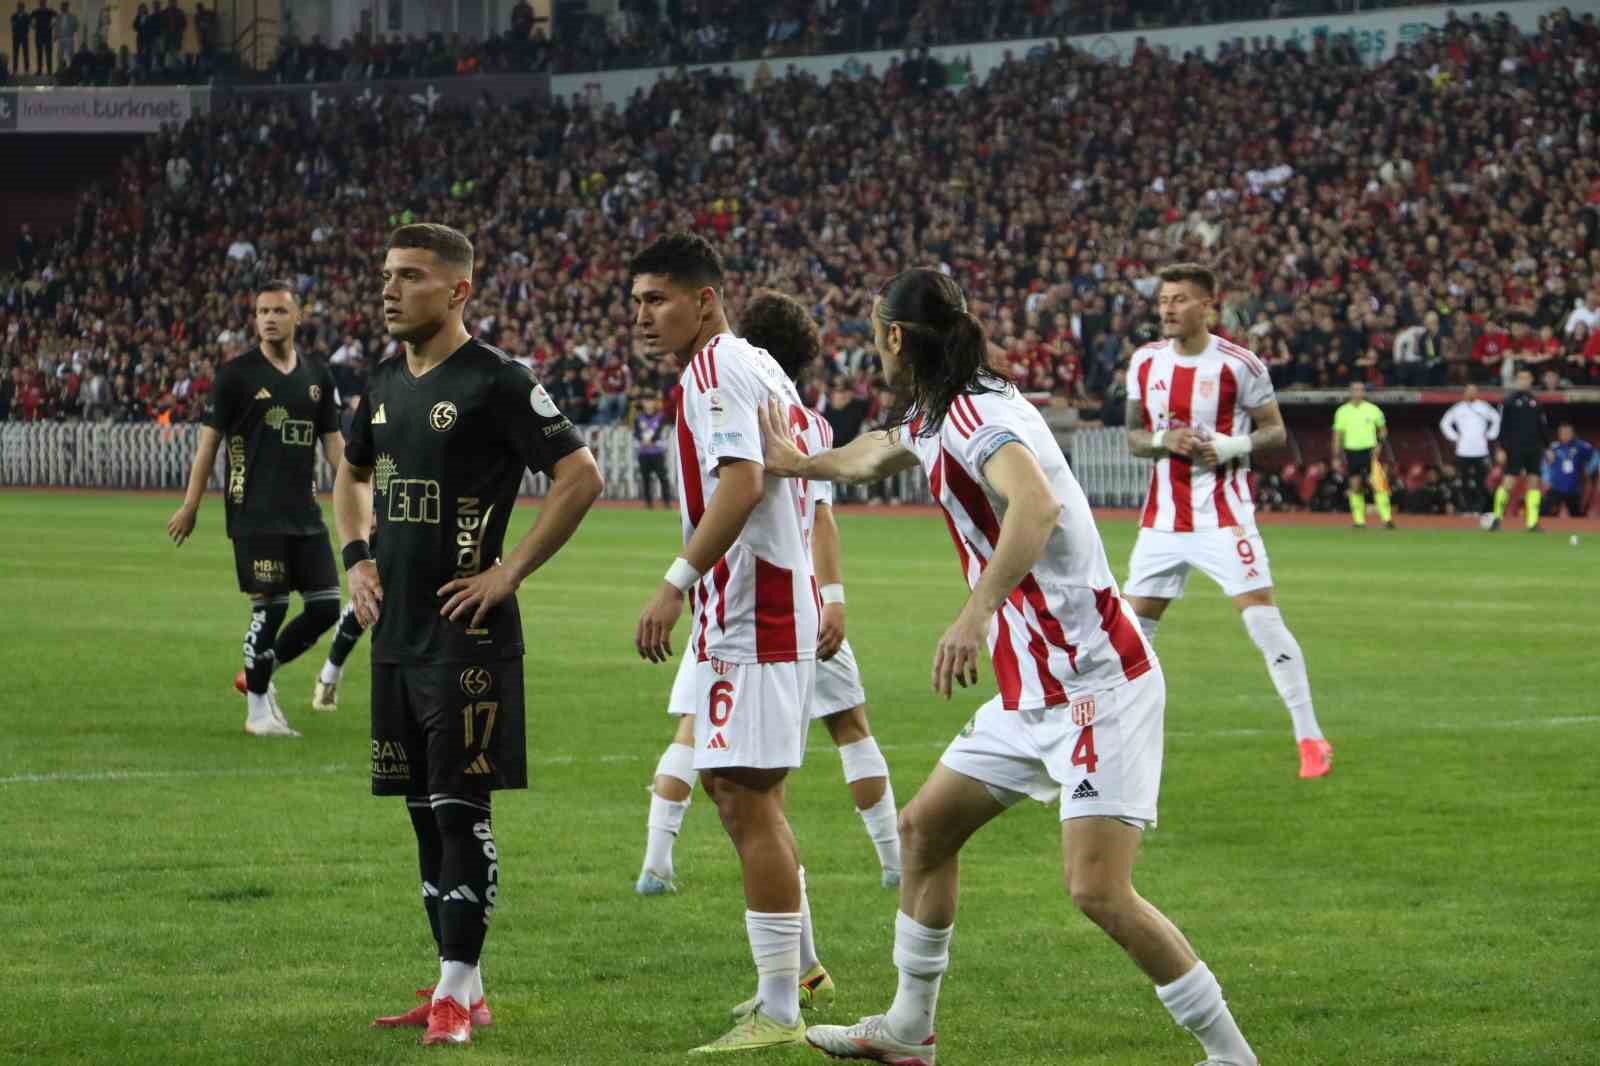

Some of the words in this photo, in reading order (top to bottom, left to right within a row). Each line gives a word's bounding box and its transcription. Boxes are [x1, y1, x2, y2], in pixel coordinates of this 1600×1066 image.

[230, 435, 246, 504] EUROPEN
[1236, 539, 1256, 565] 9
[463, 701, 498, 749] 17
[709, 680, 735, 727] 6
[1071, 726, 1099, 773] 4
[1072, 789, 1099, 800] adidas
